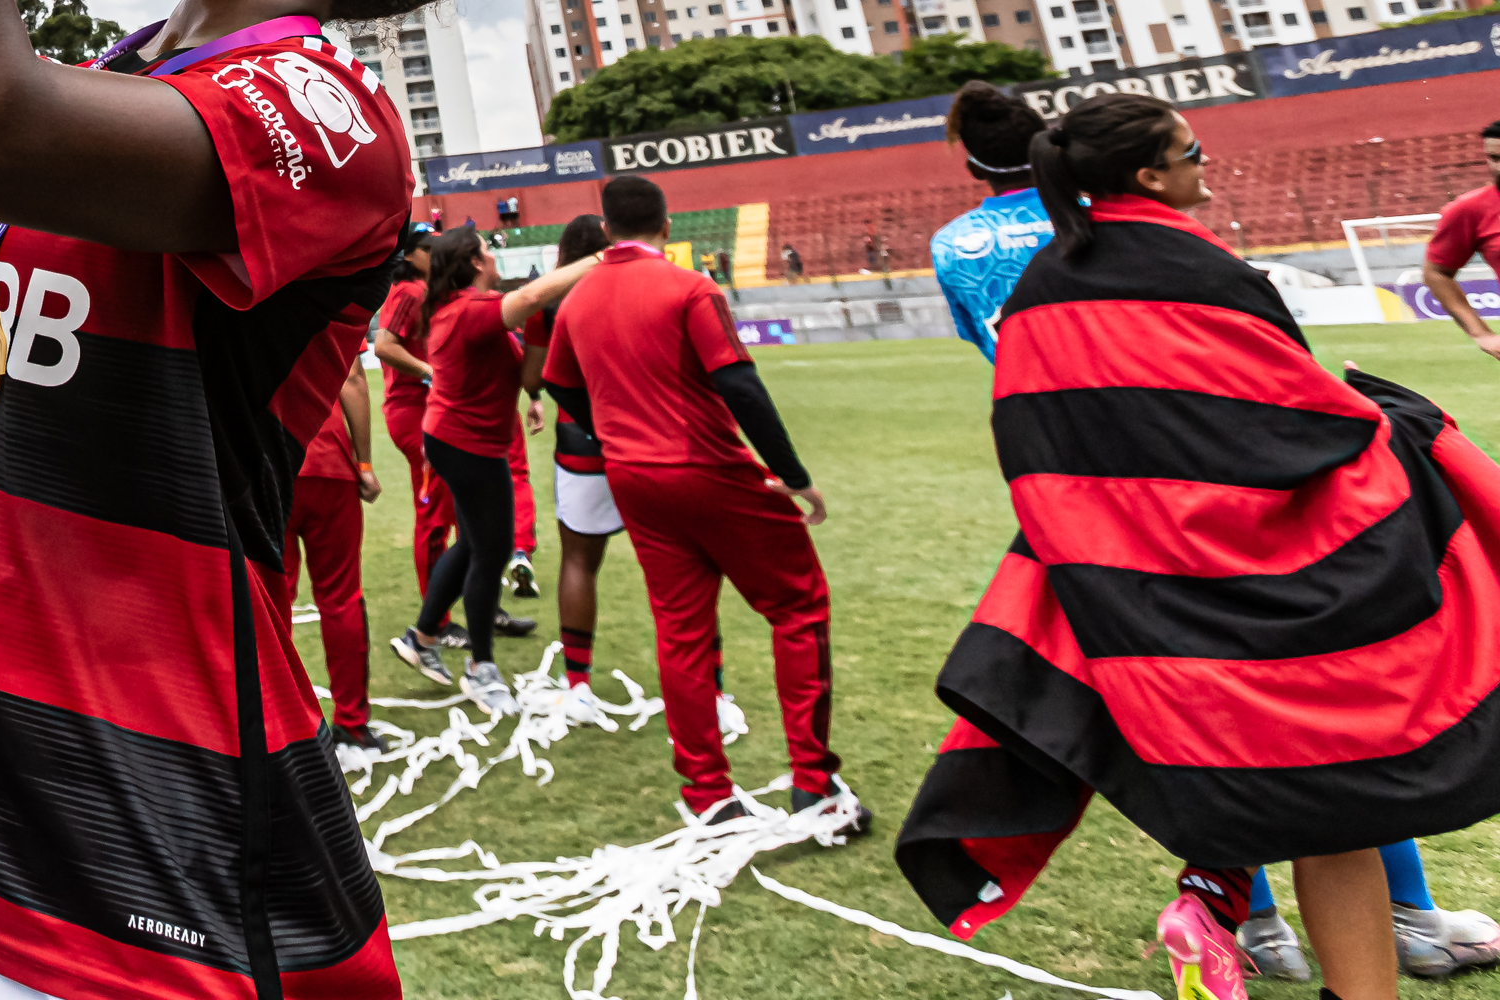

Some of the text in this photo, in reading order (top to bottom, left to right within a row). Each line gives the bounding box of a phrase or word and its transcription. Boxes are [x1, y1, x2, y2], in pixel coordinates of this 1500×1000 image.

[212, 57, 312, 190] Guaraná
[610, 126, 788, 171] ECOBIER
[127, 914, 206, 948] AEROREADY
